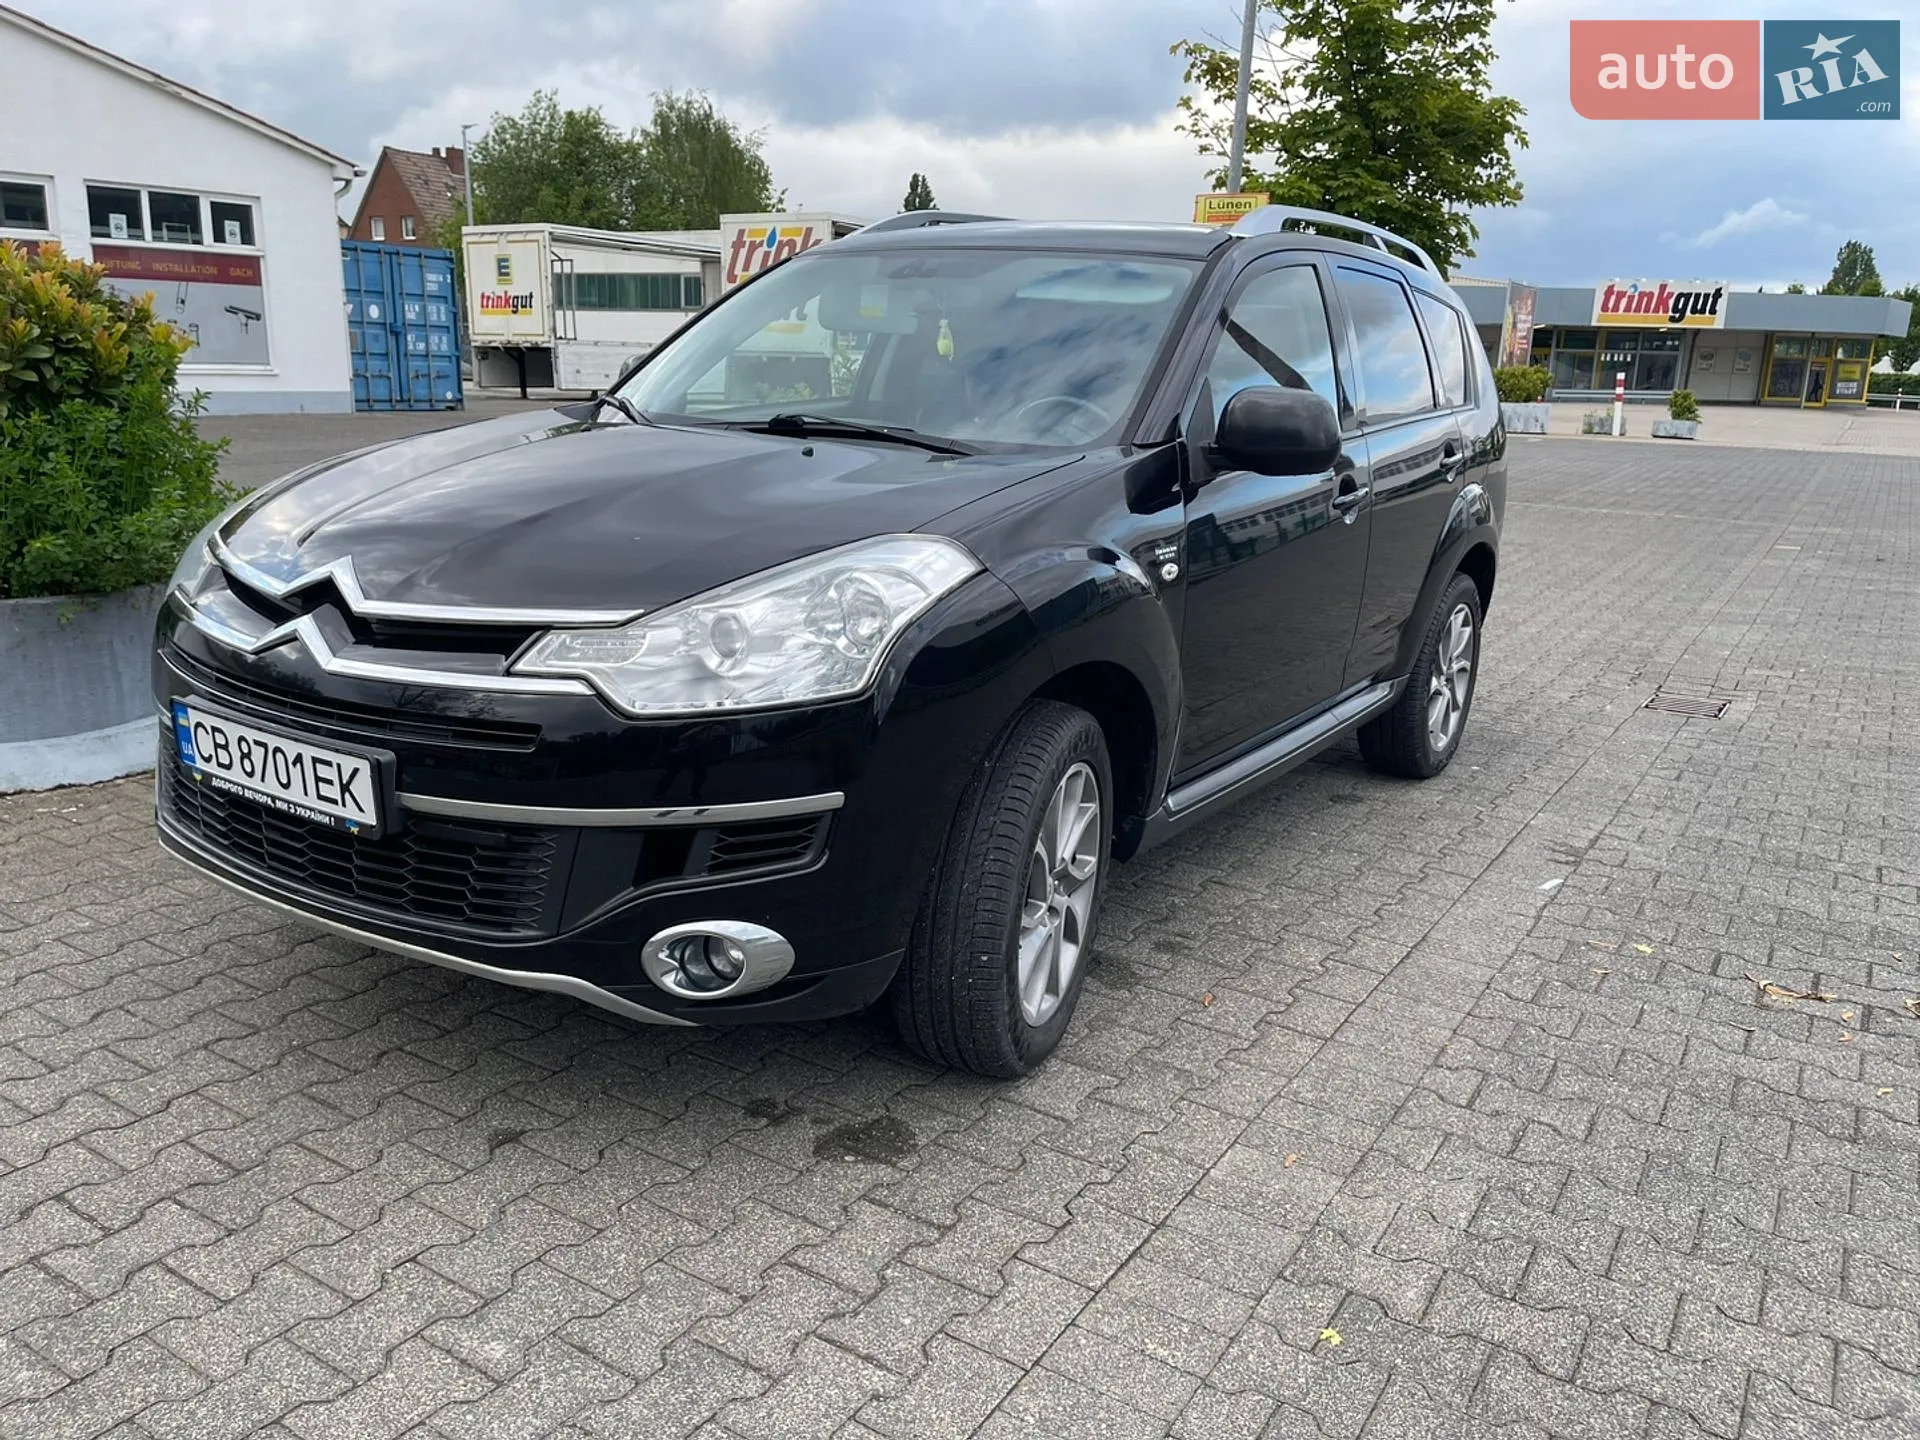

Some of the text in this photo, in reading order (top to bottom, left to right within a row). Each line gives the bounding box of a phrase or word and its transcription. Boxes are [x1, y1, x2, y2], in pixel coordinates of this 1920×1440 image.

[1208, 199, 1252, 210] Lünen
[152, 263, 218, 276] INSTALLATION
[480, 290, 534, 315] trinkgut
[1600, 283, 1723, 324] trinkgut
[181, 740, 194, 755] UA
